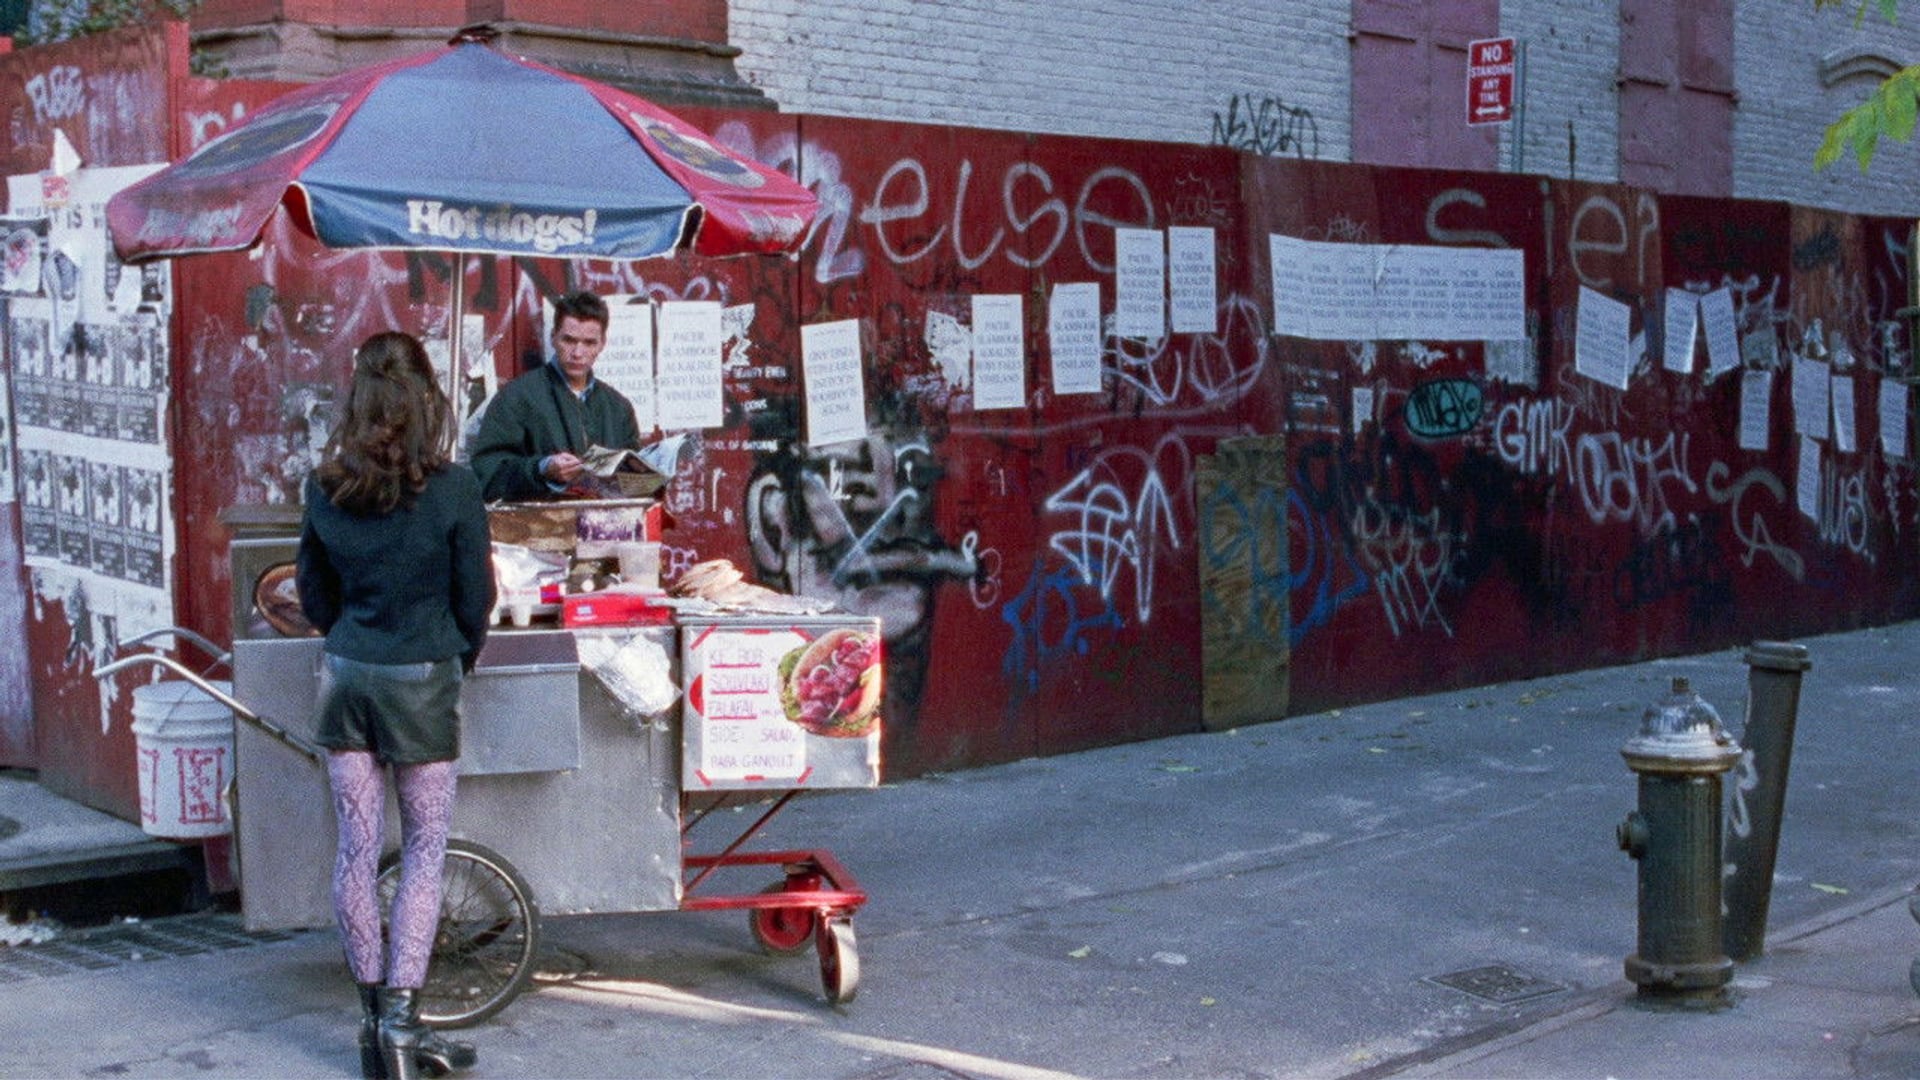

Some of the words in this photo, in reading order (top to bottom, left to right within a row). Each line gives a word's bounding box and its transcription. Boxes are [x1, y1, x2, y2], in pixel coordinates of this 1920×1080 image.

[1481, 44, 1502, 62] NO
[1471, 63, 1513, 77] STANDING
[1482, 79, 1500, 89] ANY
[1480, 91, 1501, 103] TIME
[406, 199, 482, 240] Hot
[483, 202, 598, 253] dogs!
